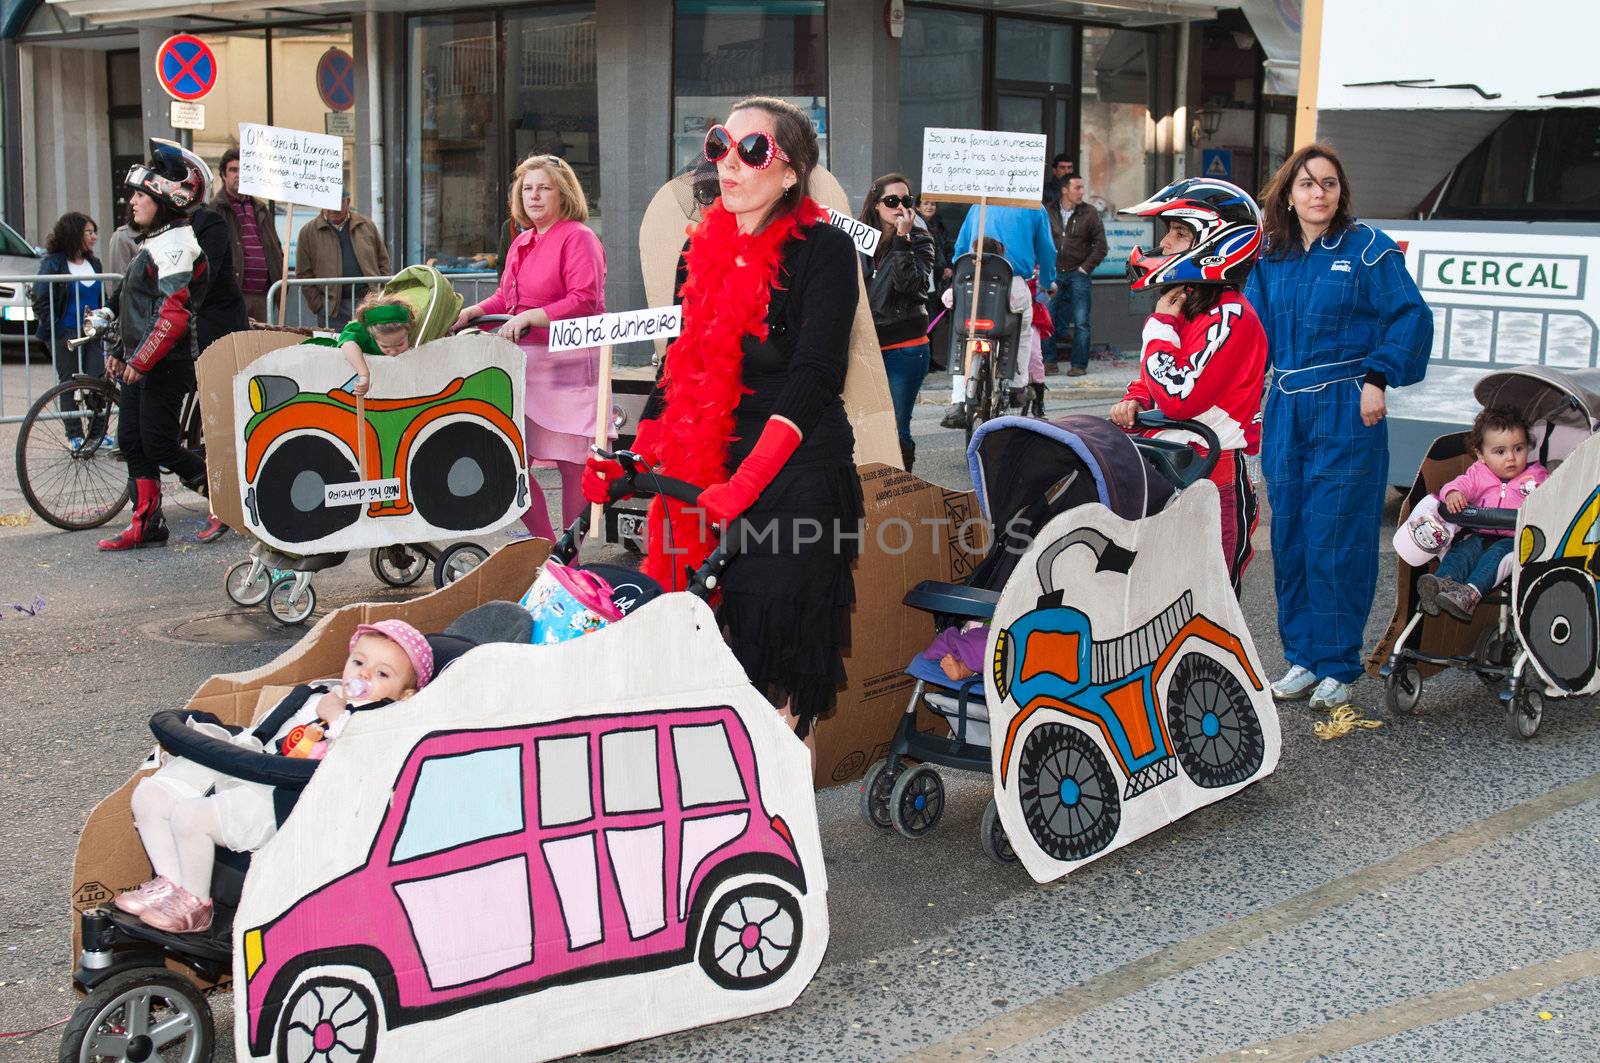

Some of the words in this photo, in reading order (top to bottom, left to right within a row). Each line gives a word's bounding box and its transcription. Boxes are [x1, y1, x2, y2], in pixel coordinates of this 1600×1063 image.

[246, 129, 255, 146] O
[1203, 256, 1222, 265] CMS
[1437, 257, 1568, 290] CERCAL
[551, 321, 582, 347] Não
[586, 316, 606, 345] há
